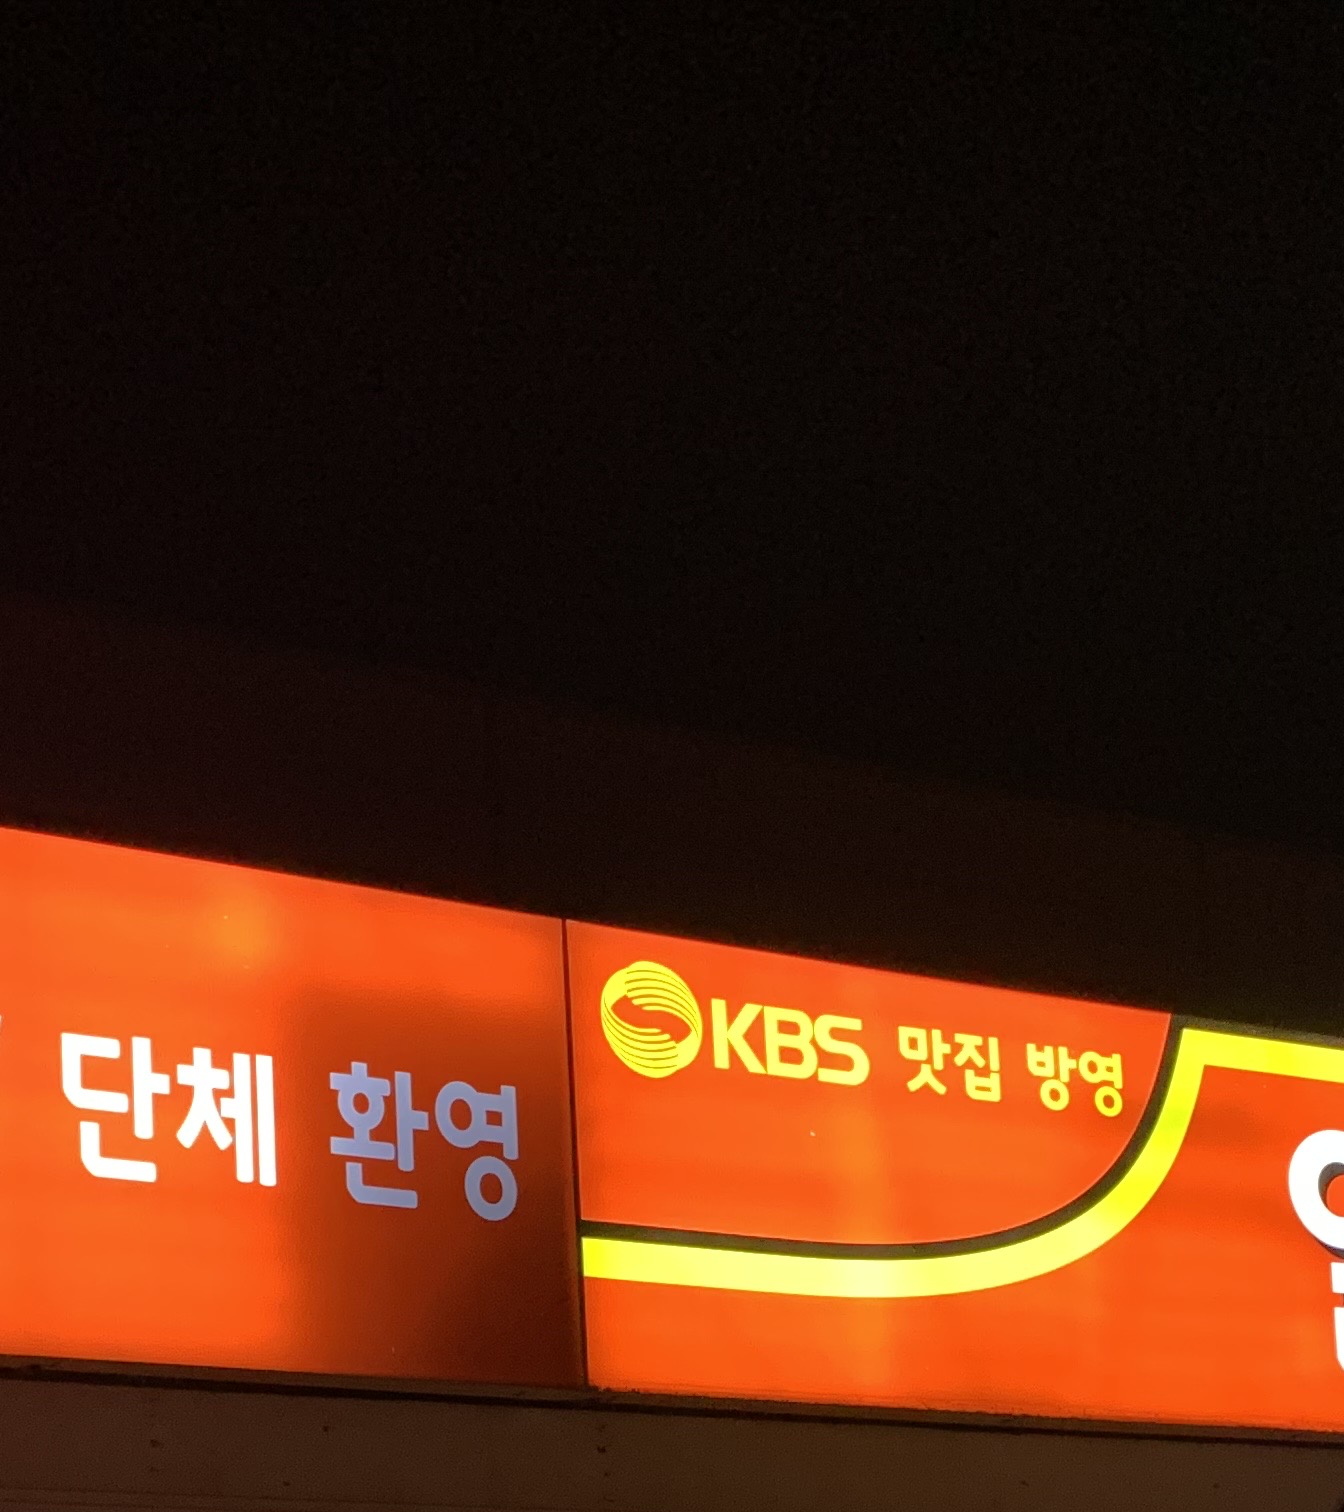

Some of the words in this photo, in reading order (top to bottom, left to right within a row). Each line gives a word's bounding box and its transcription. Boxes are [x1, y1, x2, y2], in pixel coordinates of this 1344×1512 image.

[61, 1033, 277, 1186] 단체
[330, 1062, 517, 1220] 환영
[712, 999, 869, 1085] KBS
[898, 1026, 1000, 1101] 맛집
[1027, 1044, 1122, 1116] 방영
